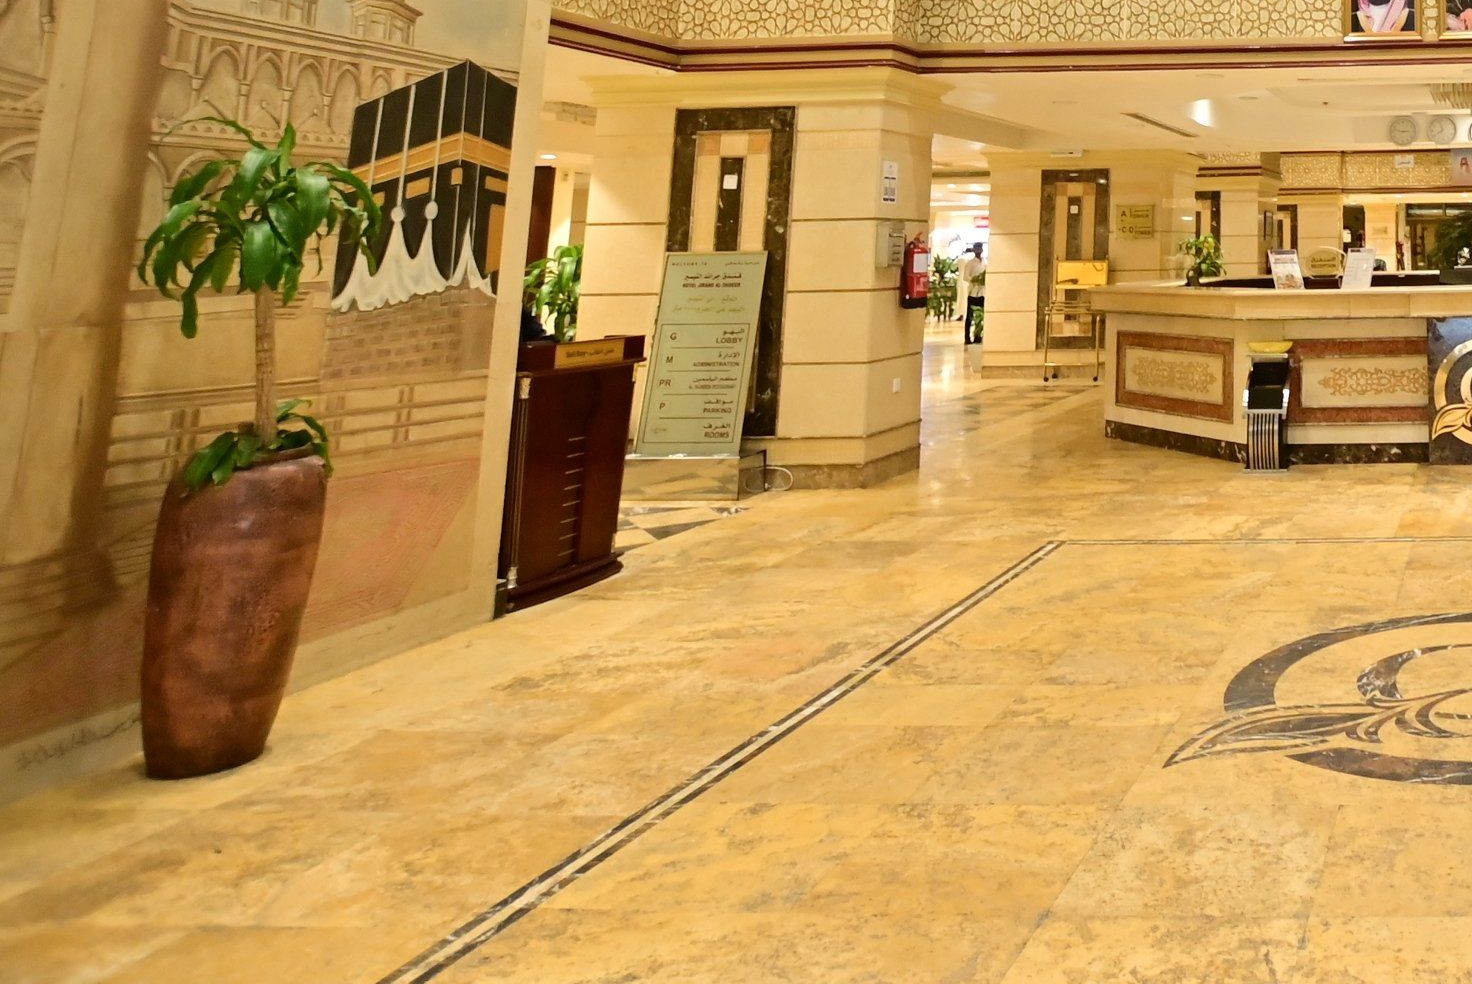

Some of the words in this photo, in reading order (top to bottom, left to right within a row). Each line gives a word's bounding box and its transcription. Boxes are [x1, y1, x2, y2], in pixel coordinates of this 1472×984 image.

[669, 332, 677, 341] G
[665, 356, 674, 364] M
[659, 379, 672, 387] PR
[659, 402, 666, 410] P
[704, 431, 730, 439] ROOMS
